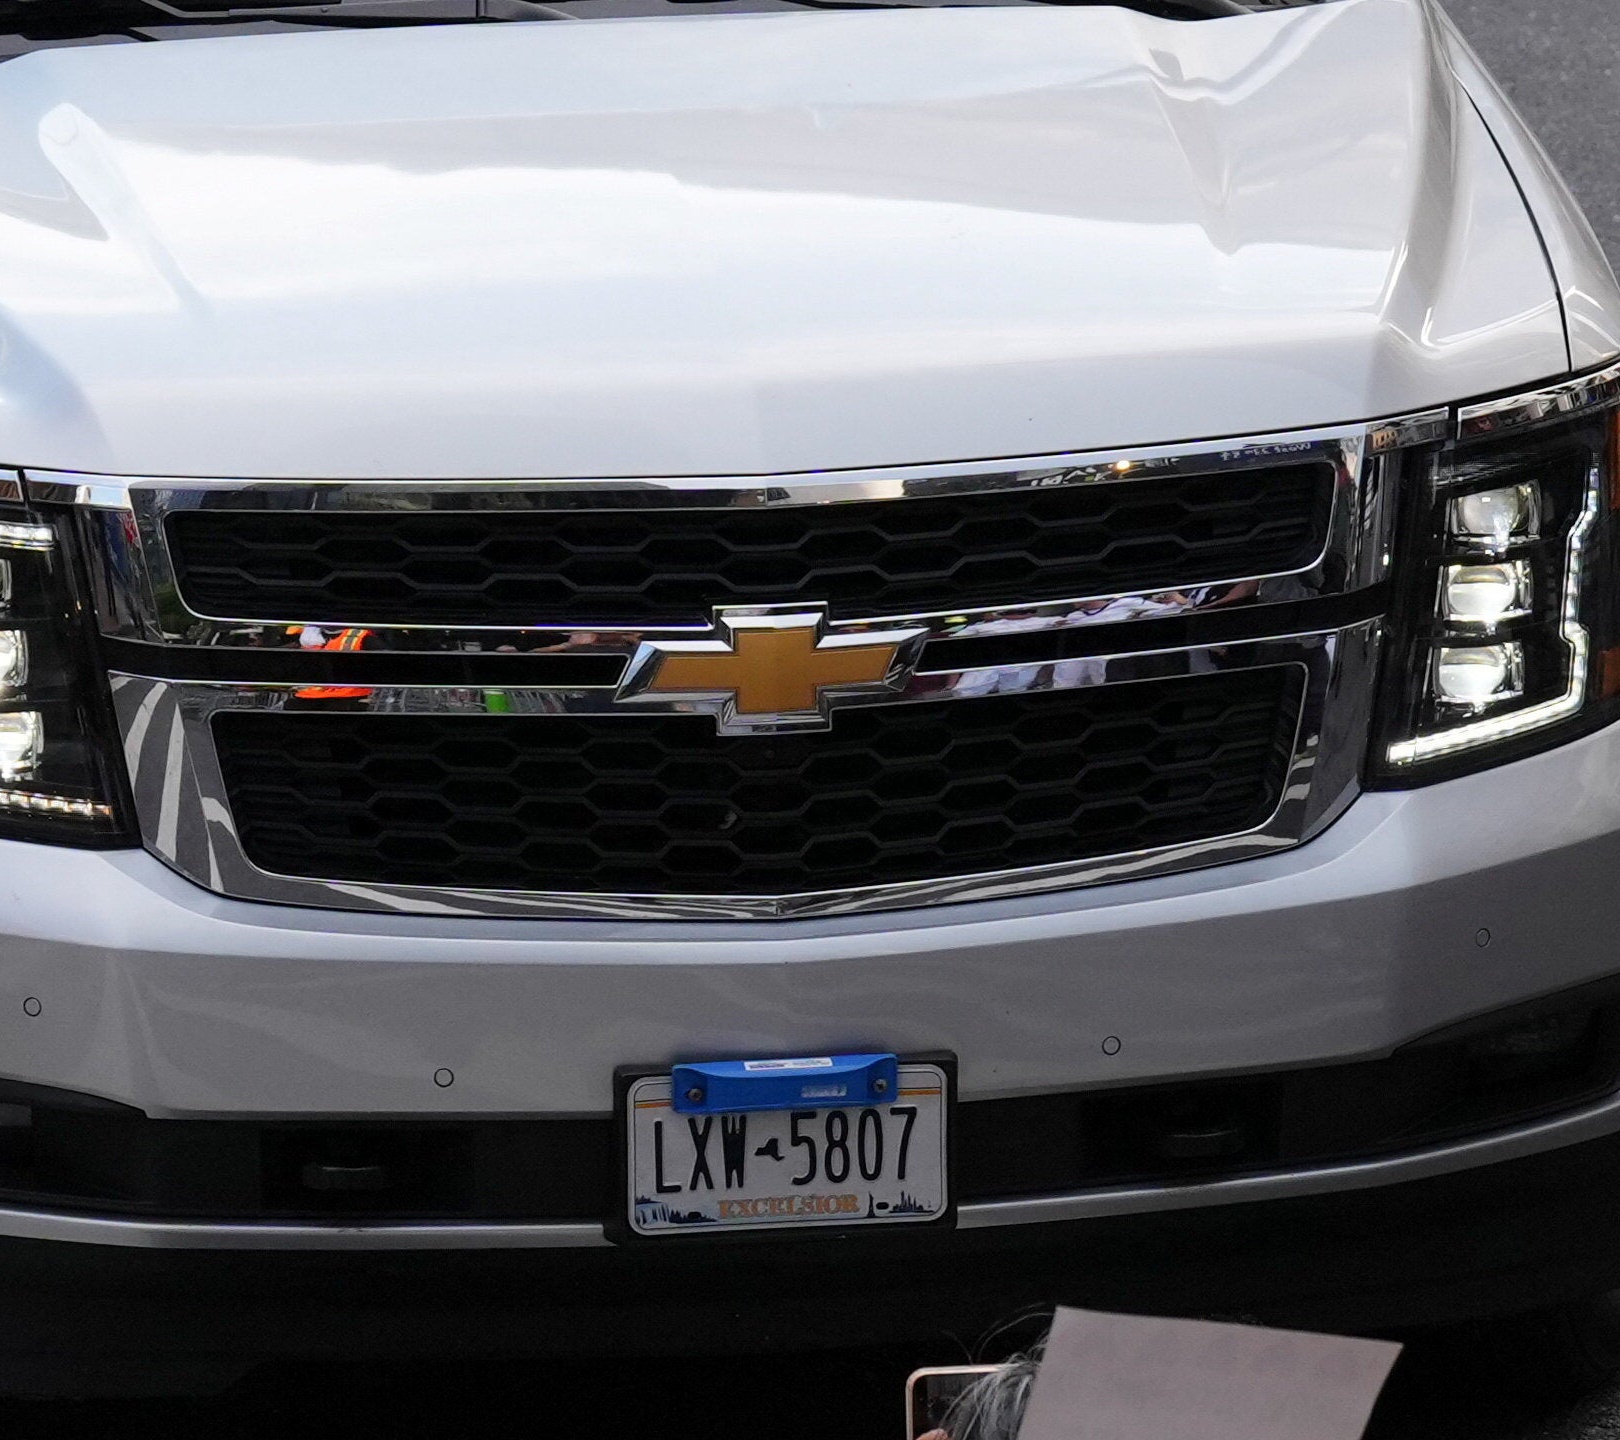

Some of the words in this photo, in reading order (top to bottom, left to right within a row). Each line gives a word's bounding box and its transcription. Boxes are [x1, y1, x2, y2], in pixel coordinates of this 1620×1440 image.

[652, 1114, 748, 1194] LXW
[790, 1106, 918, 1186] 5807
[718, 1193, 860, 1220] EXCELSIOR
